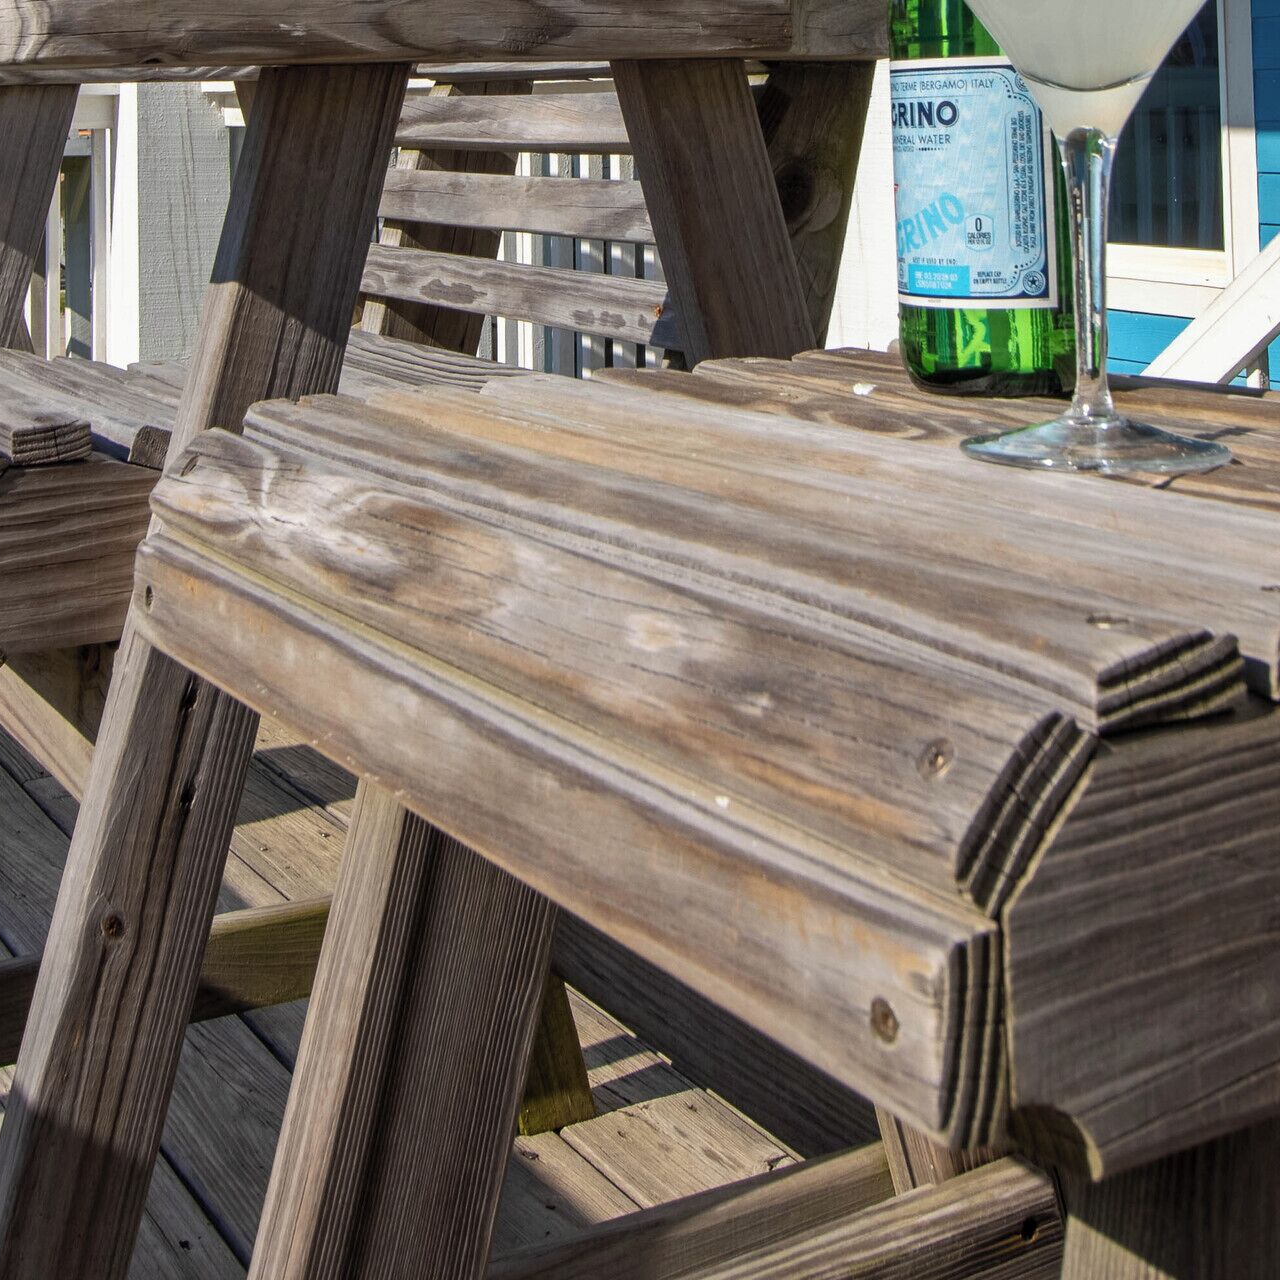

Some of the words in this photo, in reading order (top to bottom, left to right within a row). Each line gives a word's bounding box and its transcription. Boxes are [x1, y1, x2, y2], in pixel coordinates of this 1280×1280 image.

[971, 78, 994, 89] ITALY
[918, 134, 951, 144] WATER
[975, 217, 983, 232] 0
[967, 231, 992, 239] CALORIES
